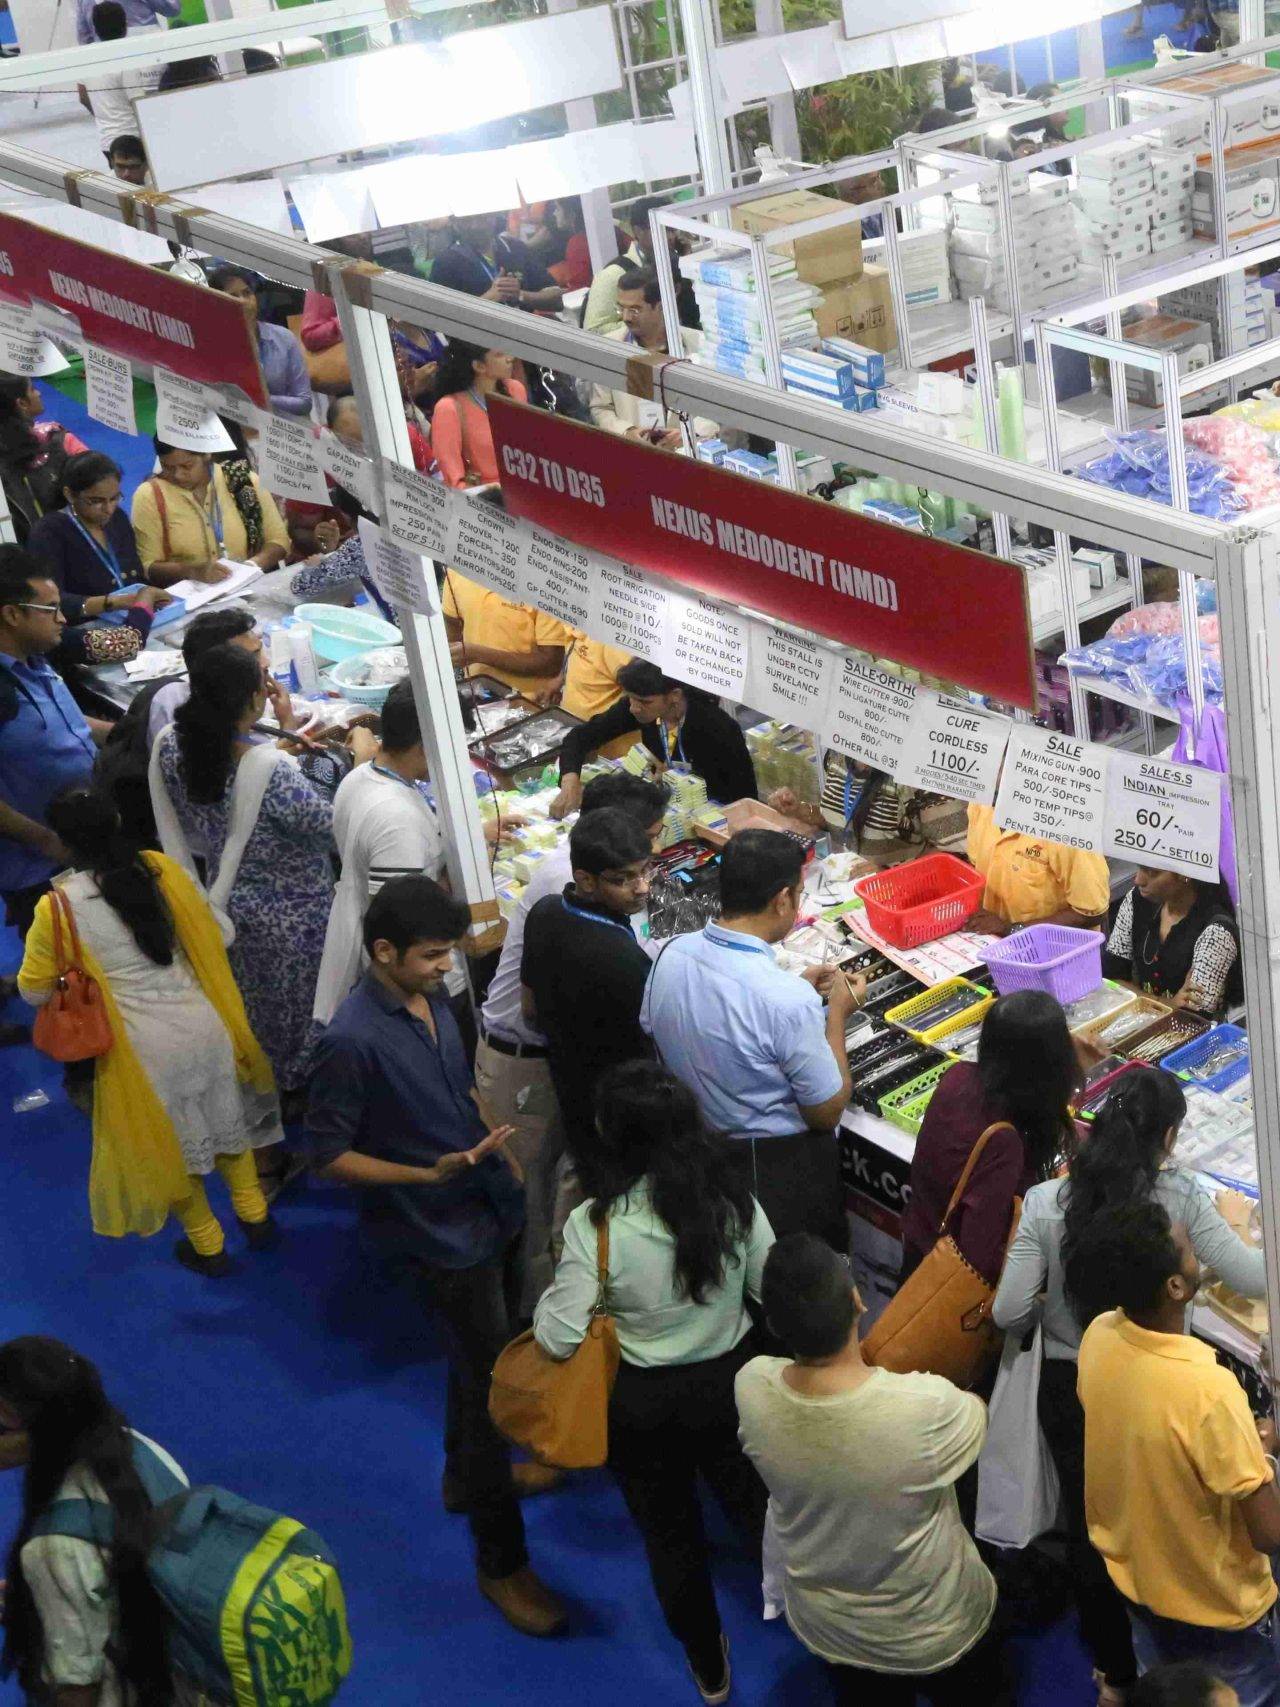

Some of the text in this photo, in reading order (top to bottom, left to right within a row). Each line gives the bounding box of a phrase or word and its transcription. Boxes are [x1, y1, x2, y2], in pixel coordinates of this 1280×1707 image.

[49, 269, 90, 307] NEXUS
[891, 398, 919, 413] SLEEVES
[392, 524, 406, 536] SET
[407, 532, 420, 542] OF
[459, 519, 492, 540] REMOVER
[477, 513, 505, 534] CROWN
[502, 444, 899, 612] C32 TO D35 NEXUS MEDODENT (NMD)
[458, 532, 517, 566] FORCEPS 350
[531, 544, 552, 561] ENDO
[532, 531, 554, 549] ENDO
[555, 545, 571, 557] BOX
[453, 555, 486, 574] MIRROR
[527, 555, 548, 573] ENDO
[622, 565, 643, 581] SALE
[601, 569, 666, 603] ROOT IRRIGATION
[540, 590, 568, 609] CUTTER
[603, 601, 634, 619] VENTED
[609, 587, 657, 613] NEEDLE SIDE
[537, 601, 578, 626] CORDLESS
[686, 608, 740, 636] GOODS ONCE
[681, 622, 742, 652] SOLD WILL NOT
[677, 635, 744, 666] BE TAKEN BACK
[767, 637, 824, 668] THIS STALL IS
[675, 648, 744, 679] OR EXCHANGED
[767, 653, 820, 681] UNDER CCTV
[701, 671, 732, 688] ORDER
[765, 666, 820, 696] SURVELANCE
[842, 674, 865, 689] WIRE
[863, 684, 891, 702] CUTTER
[772, 683, 796, 702] SMILE
[839, 686, 852, 698] PIN
[852, 692, 886, 712] LIGATURE
[838, 710, 863, 727] DISTAL
[864, 721, 879, 734] END
[946, 715, 980, 732] CURE
[832, 733, 879, 762] OTHER ALL
[929, 730, 989, 755] CORDLESS
[1046, 736, 1084, 758] SALE
[931, 749, 980, 774] 1100/-
[1020, 748, 1055, 767] MIXING
[1055, 760, 1075, 773] GUN
[1015, 761, 1092, 793] PARA CORE TIPS
[1140, 763, 1193, 785] SALE-S.S
[1012, 790, 1032, 805] PRO
[1034, 798, 1061, 812] TEMP
[1123, 775, 1210, 807] INDIAN IMPRESSION
[1157, 800, 1174, 810] TRAY
[1004, 817, 1037, 835] PENTA
[1033, 812, 1065, 827] 350/-
[1136, 808, 1194, 838] 60/- PAIR
[1114, 829, 1146, 848] 250
[1169, 847, 1213, 866] SET(10)
